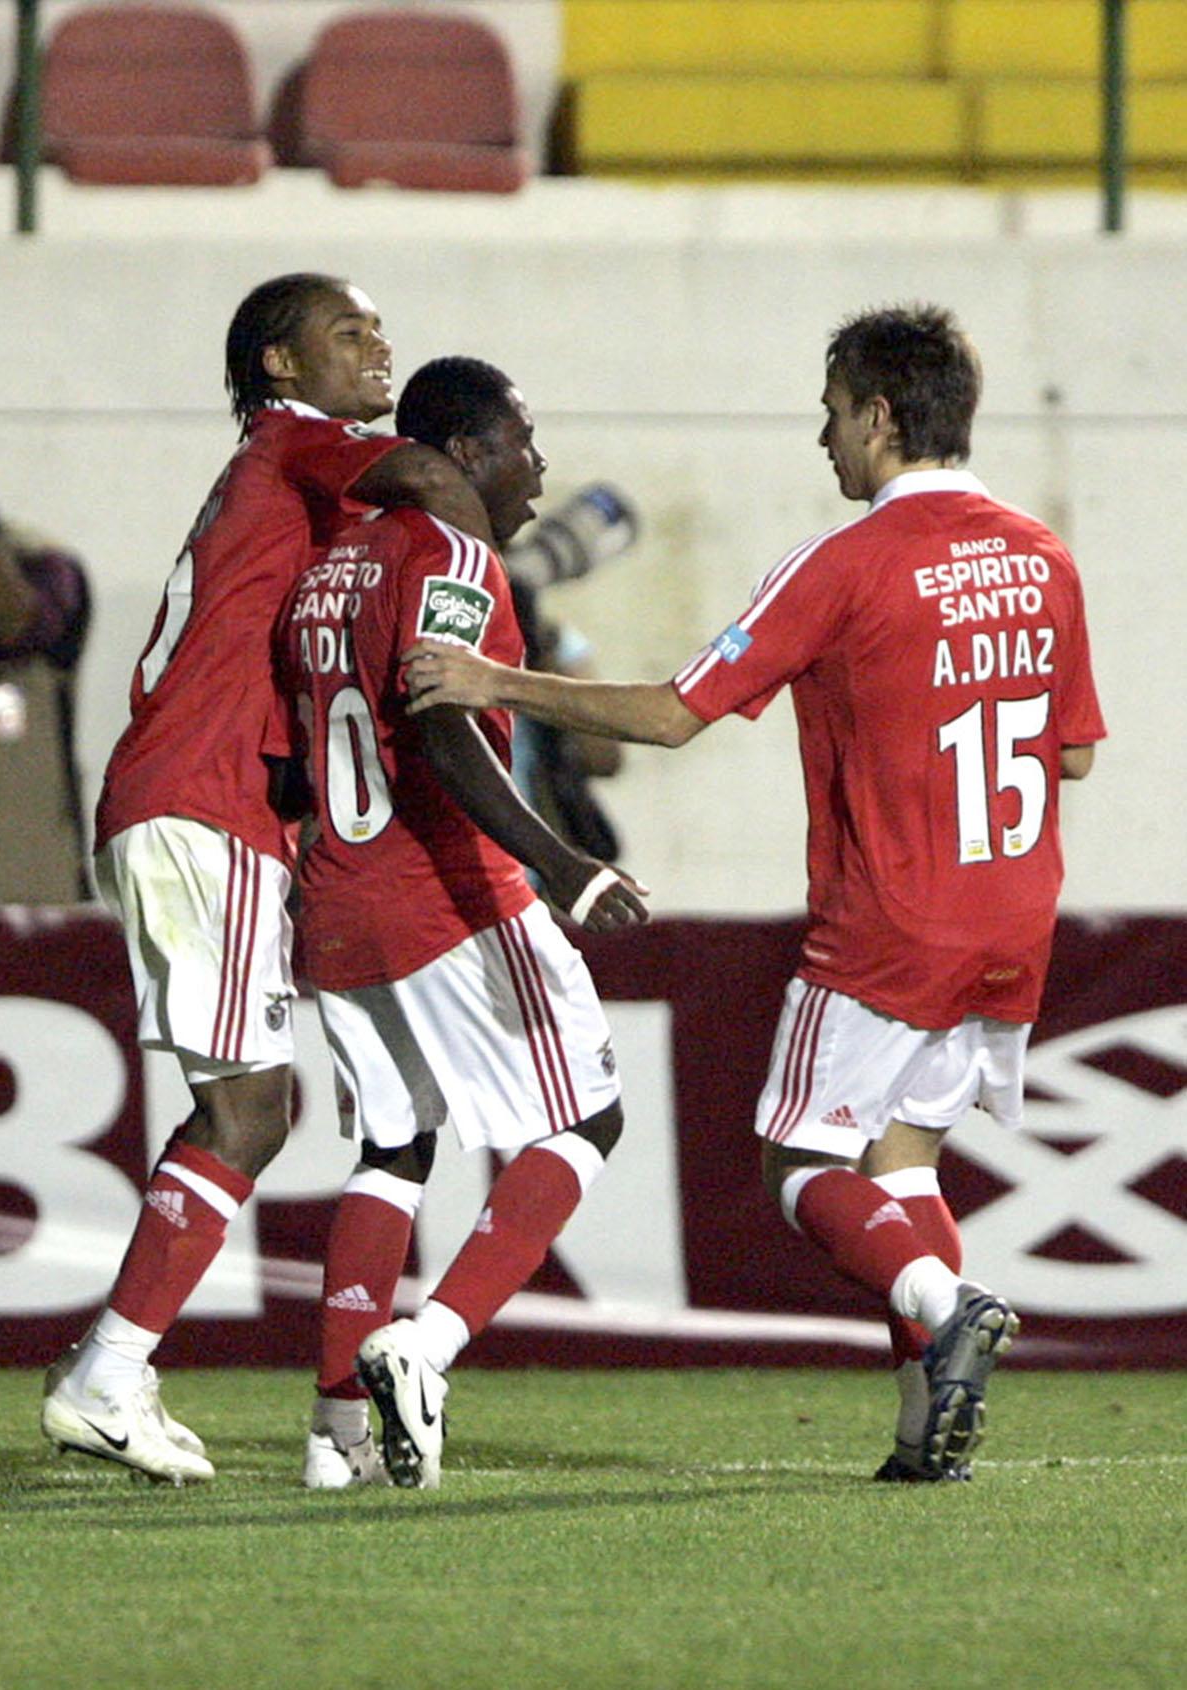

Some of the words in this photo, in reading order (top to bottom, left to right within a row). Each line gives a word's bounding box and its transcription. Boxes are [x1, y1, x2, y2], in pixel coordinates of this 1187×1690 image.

[949, 537, 1007, 558] BANCO
[914, 554, 1050, 598] ESPIRITO
[939, 585, 1043, 627] SANTO
[933, 628, 1055, 688] A.DIAZ
[937, 690, 1052, 864] 15
